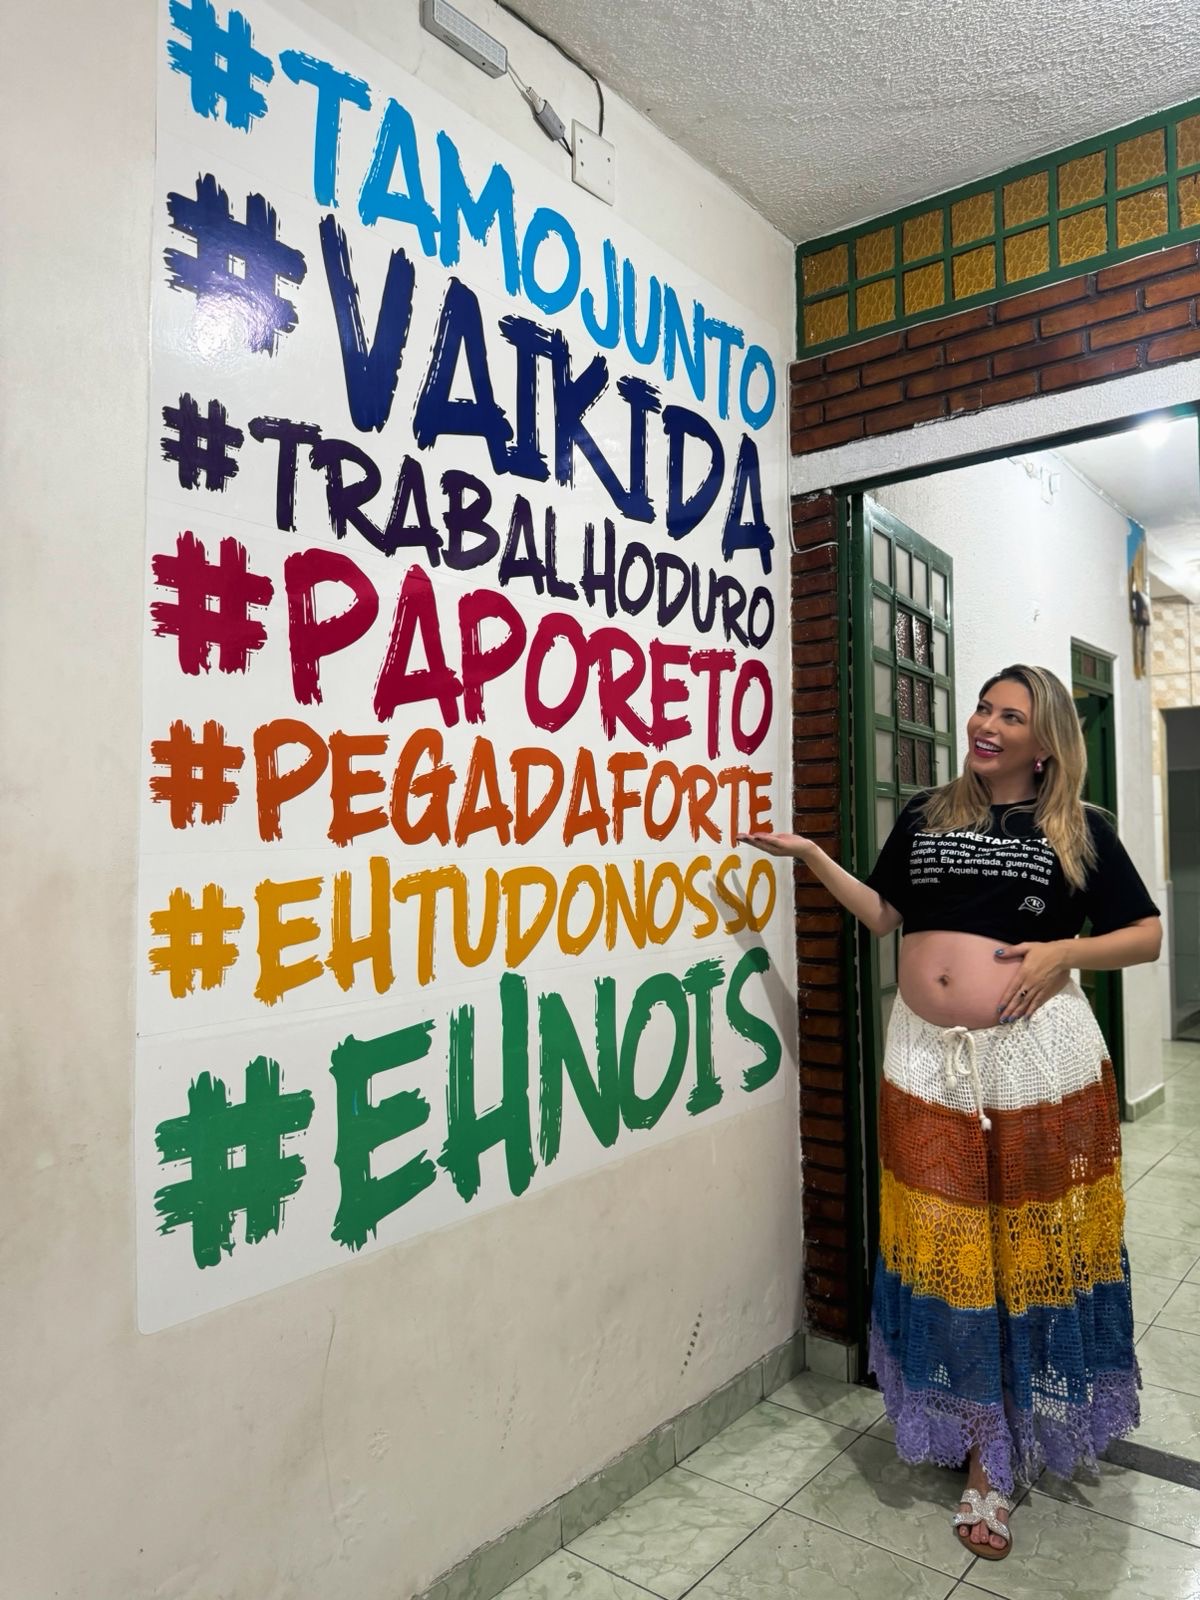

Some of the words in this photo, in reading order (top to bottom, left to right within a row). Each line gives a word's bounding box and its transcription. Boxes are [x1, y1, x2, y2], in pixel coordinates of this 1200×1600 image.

[167, 0, 776, 431] #TAMOJUNTO
[163, 173, 775, 575] #VAIKIDA
[160, 392, 775, 649] #TRABALHODURO
[151, 531, 774, 760] #PAPORETO
[150, 719, 774, 848] #PEGADAFORTE
[940, 849, 971, 858] grande
[996, 851, 1029, 860] sempre
[1033, 854, 1054, 866] cabe
[1021, 843, 1040, 852] Tem
[149, 855, 777, 1006] #EHTUDONOSSO
[941, 856, 955, 864] Ela
[1005, 860, 1045, 873] guerreira
[1045, 868, 1052, 876] e
[948, 866, 979, 876] Aquela
[982, 868, 999, 877] que
[1001, 869, 1019, 878] não
[1021, 871, 1028, 879] é
[1030, 874, 1050, 886] suas
[154, 947, 782, 1269] #EHNOIS
